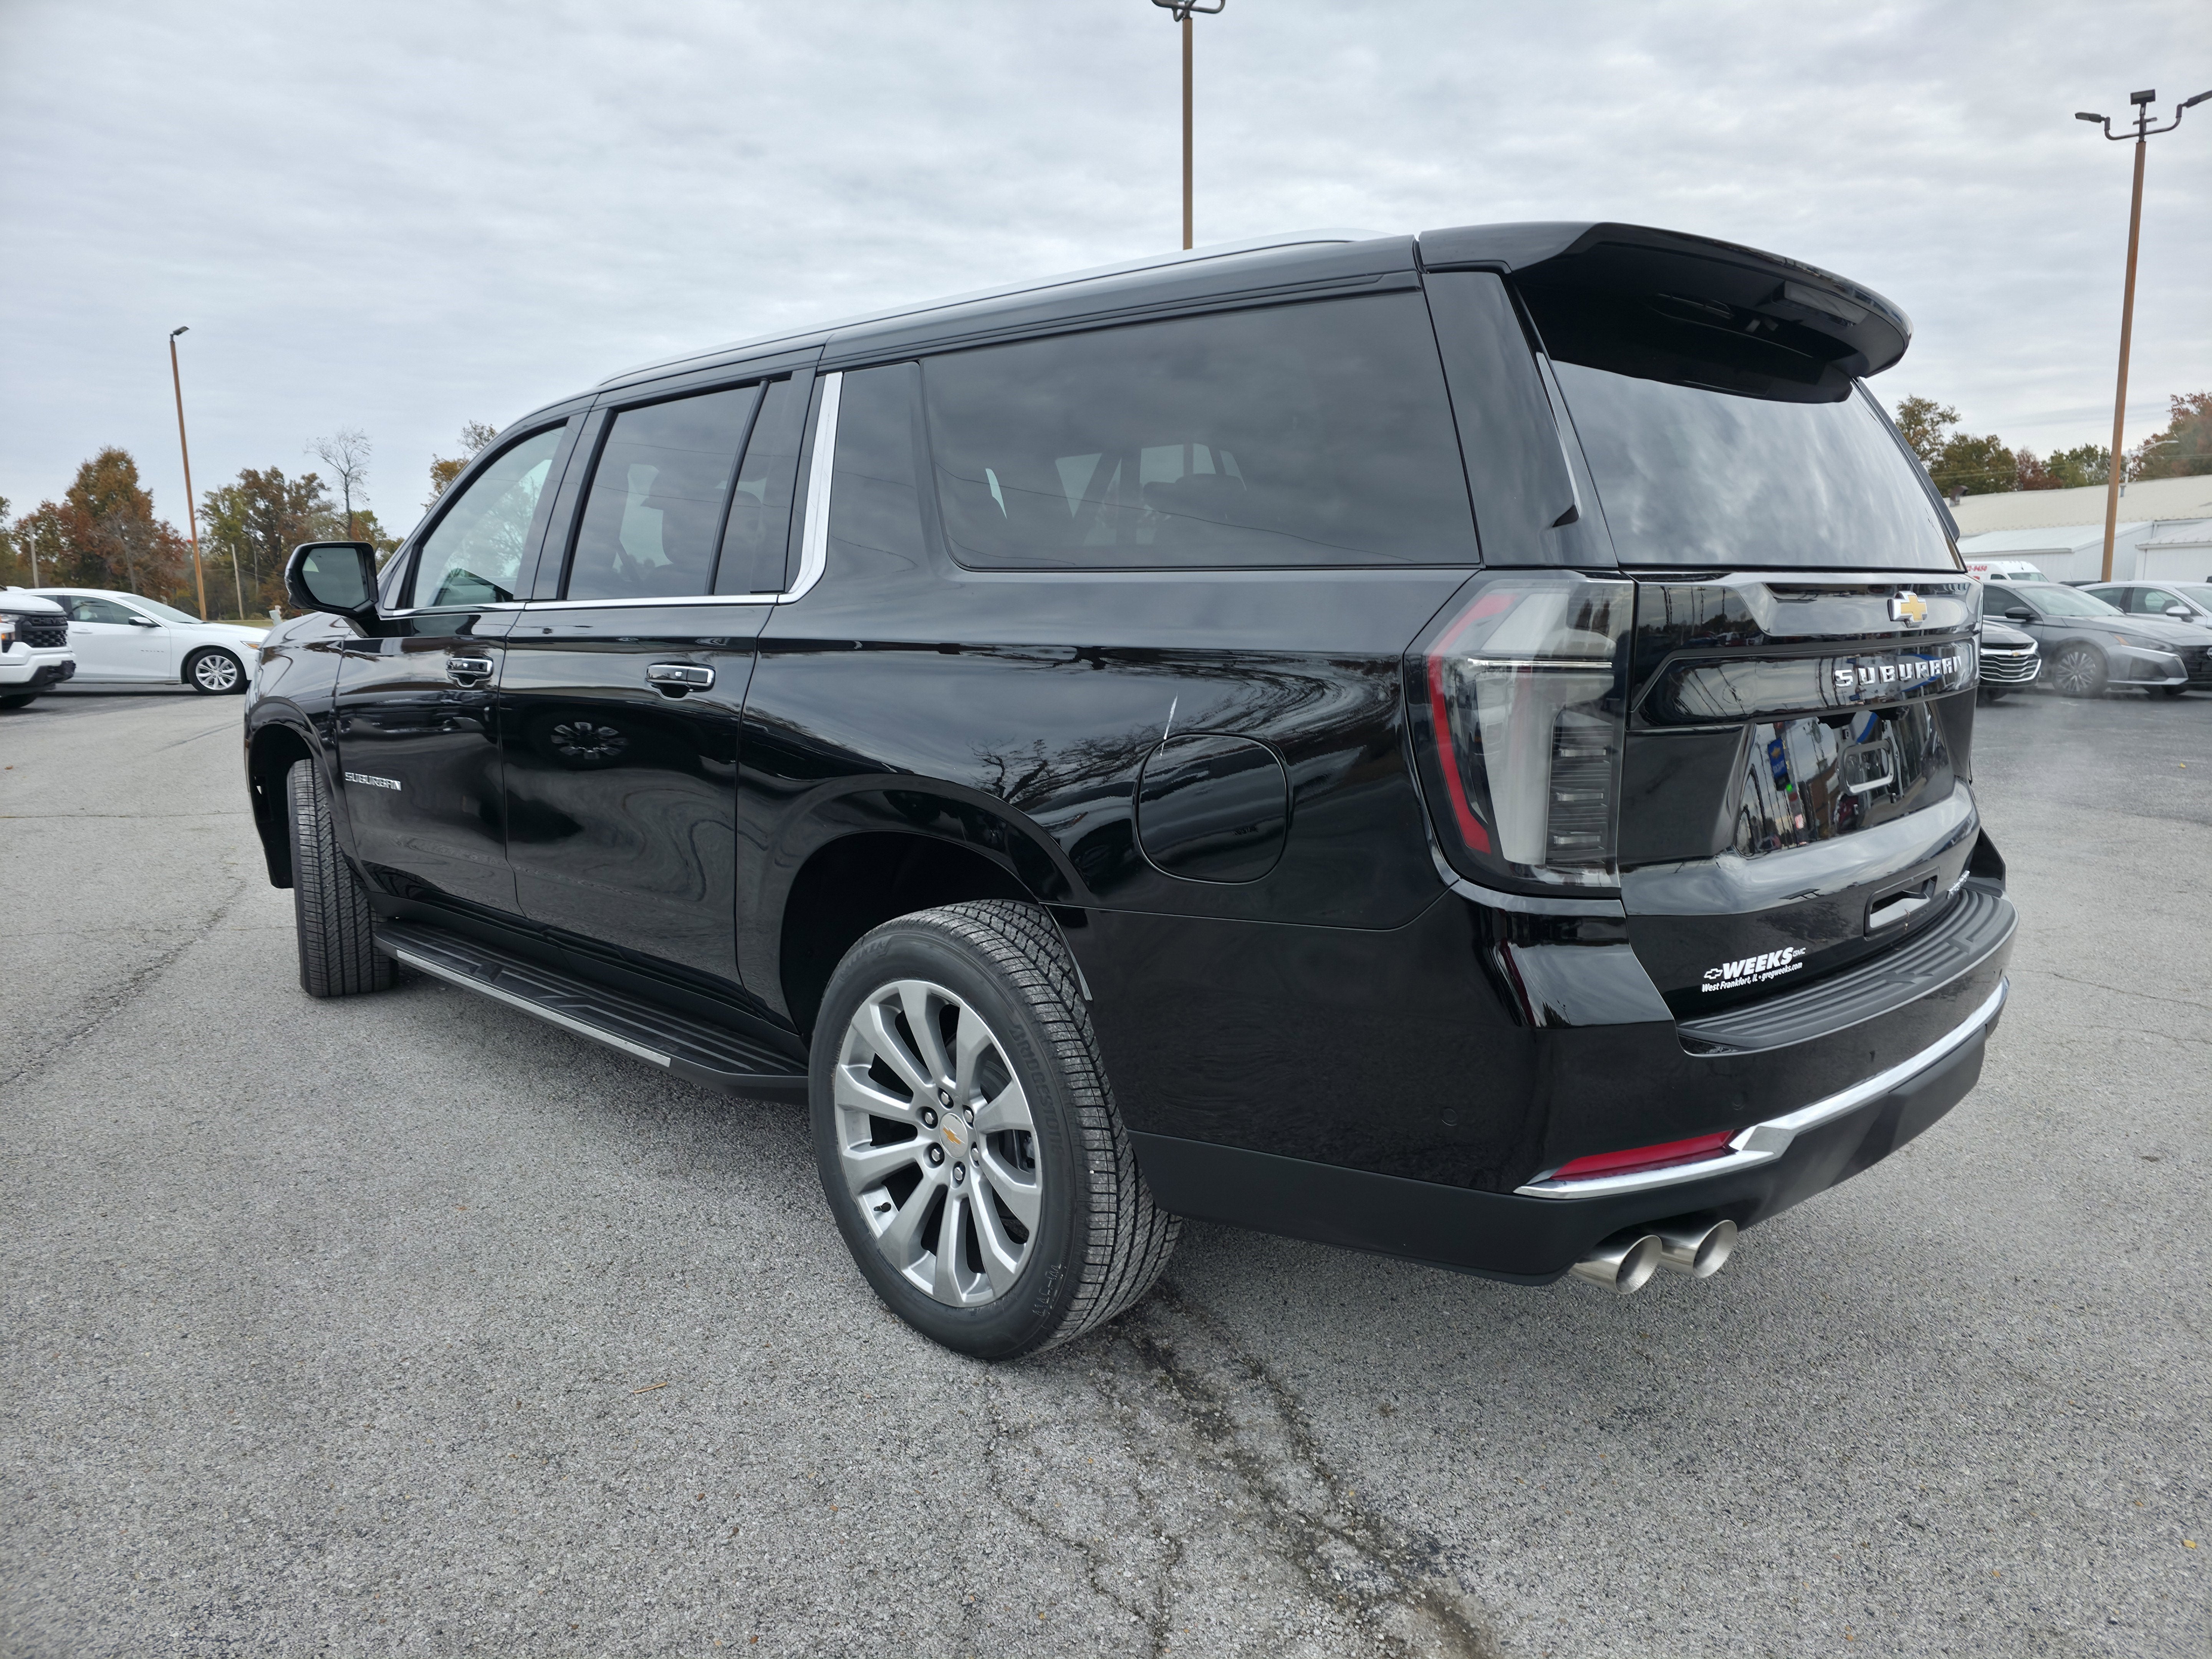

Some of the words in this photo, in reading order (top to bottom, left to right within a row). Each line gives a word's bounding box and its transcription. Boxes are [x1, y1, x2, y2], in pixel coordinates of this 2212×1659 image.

[1834, 656, 1962, 687] SUBURBAN
[345, 772, 401, 791] SUBURBAN
[1723, 947, 1794, 980] WEEKS
[1702, 982, 1720, 992] West
[1720, 976, 1752, 990] Frankfort,
[1008, 1024, 1065, 1155] BRIDGESTONE
